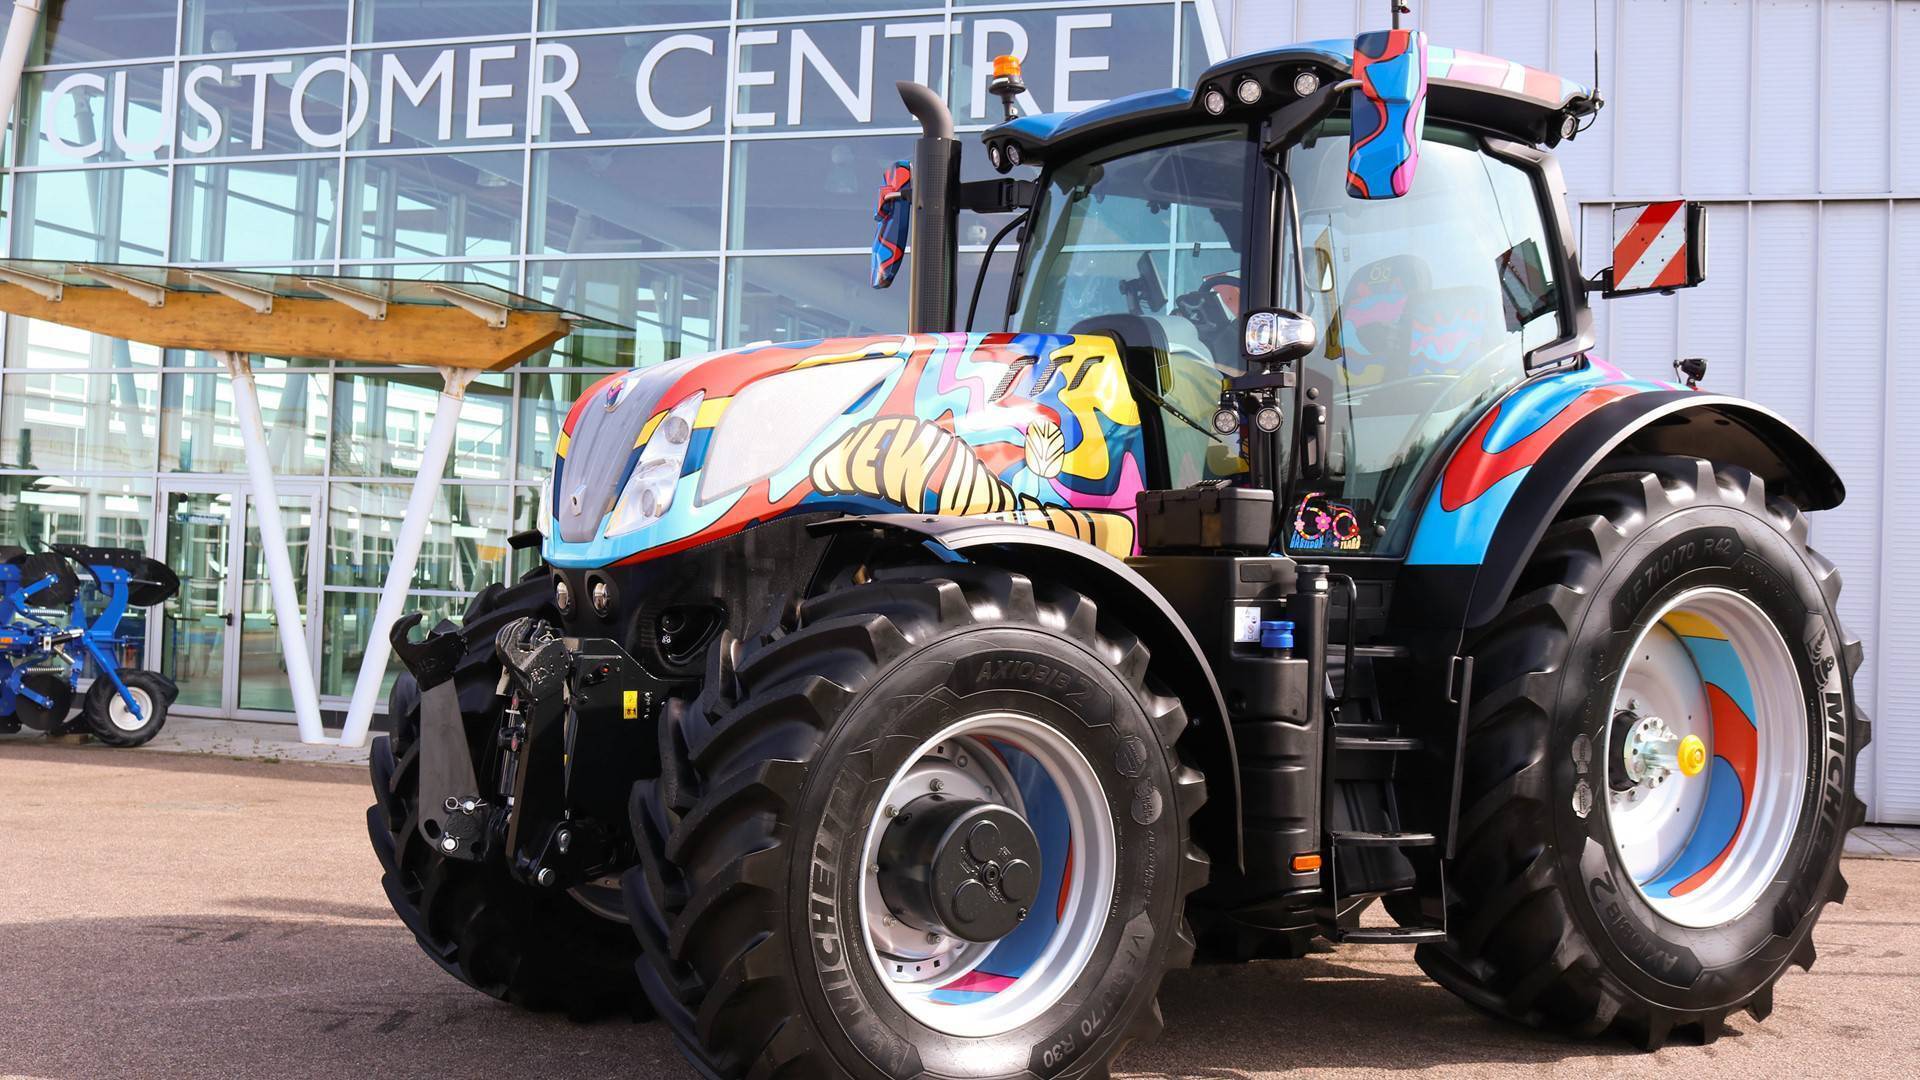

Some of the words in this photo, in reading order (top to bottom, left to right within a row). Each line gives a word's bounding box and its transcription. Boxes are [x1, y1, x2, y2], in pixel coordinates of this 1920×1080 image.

[46, 43, 592, 158] CUSTOMER
[635, 13, 1113, 131] CENTRE
[809, 414, 954, 513] NEW
[1645, 542, 1696, 582] 710/70
[1703, 538, 1734, 555] R42
[1043, 1033, 1078, 1068] R30
